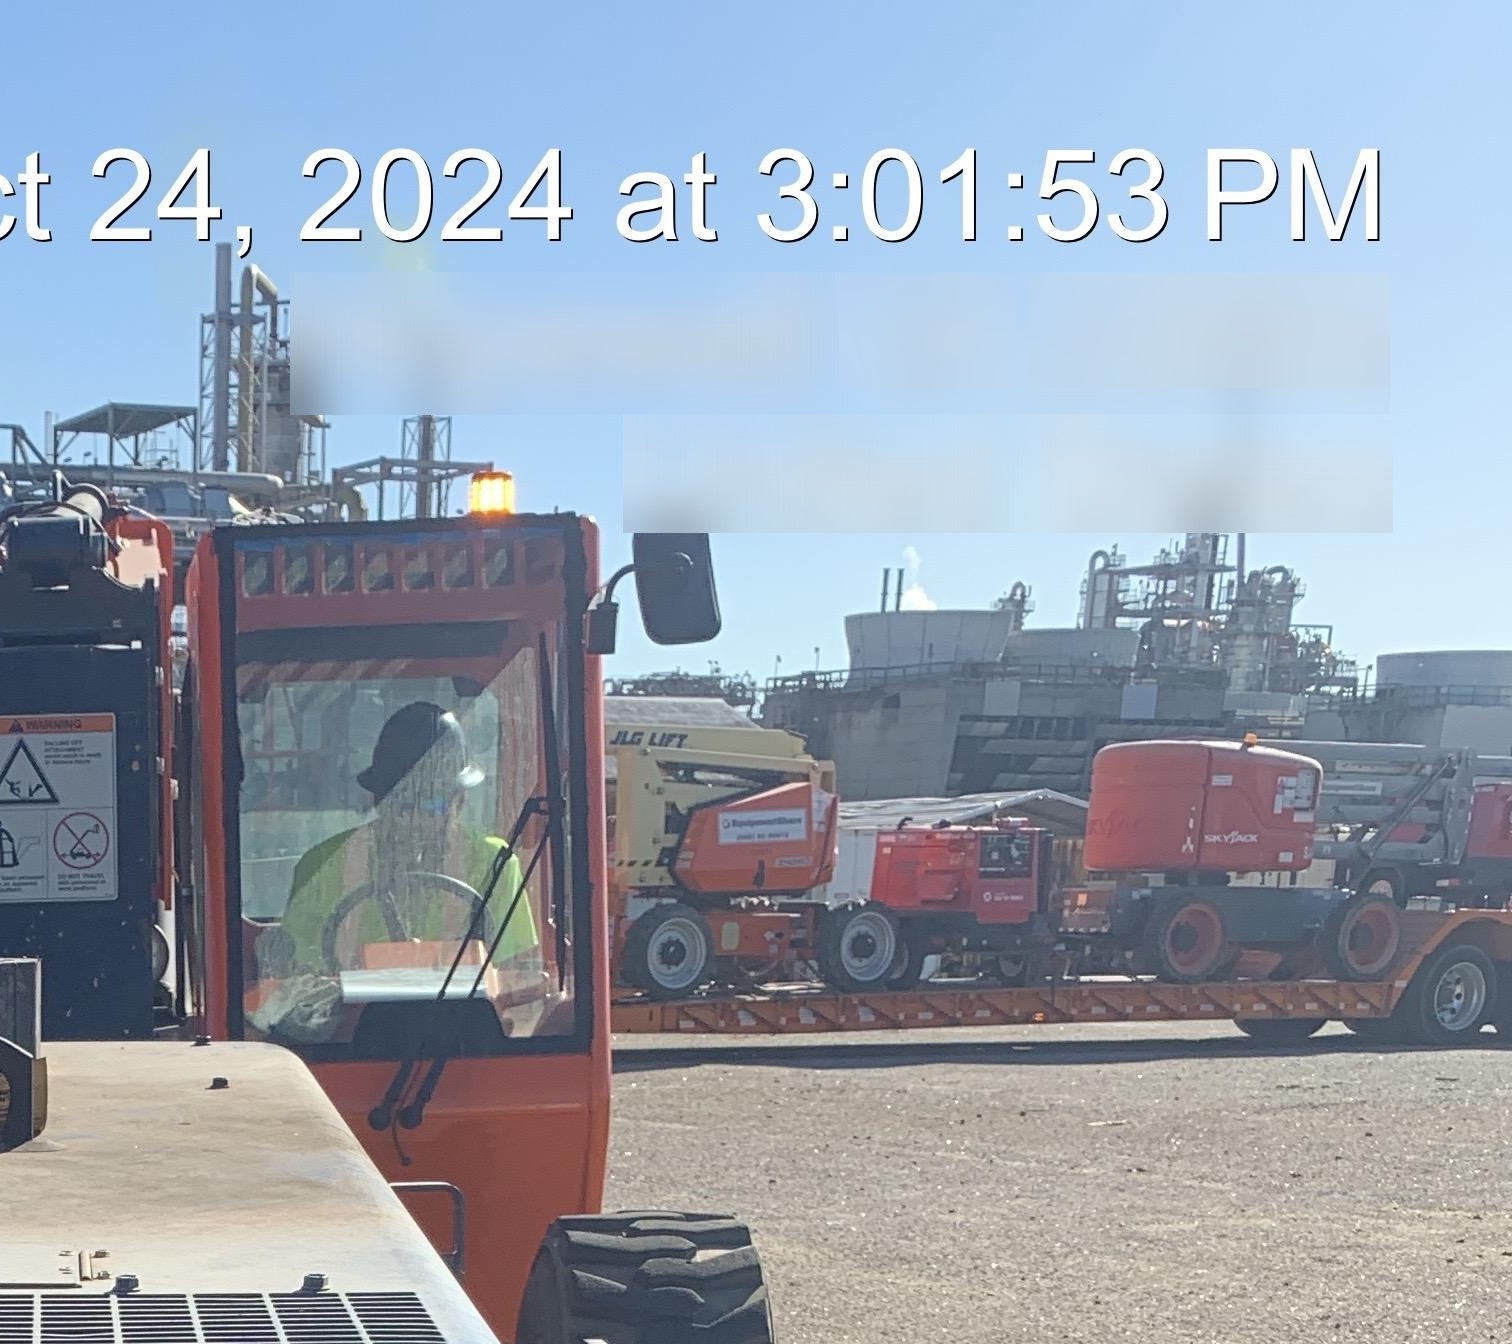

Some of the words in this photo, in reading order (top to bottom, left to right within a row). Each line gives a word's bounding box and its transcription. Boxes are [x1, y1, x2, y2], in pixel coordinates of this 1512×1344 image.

[26, 718, 82, 730] WARNING
[609, 730, 644, 745] JLG
[649, 732, 688, 748] LIFT
[1204, 830, 1258, 846] SKYJACK
